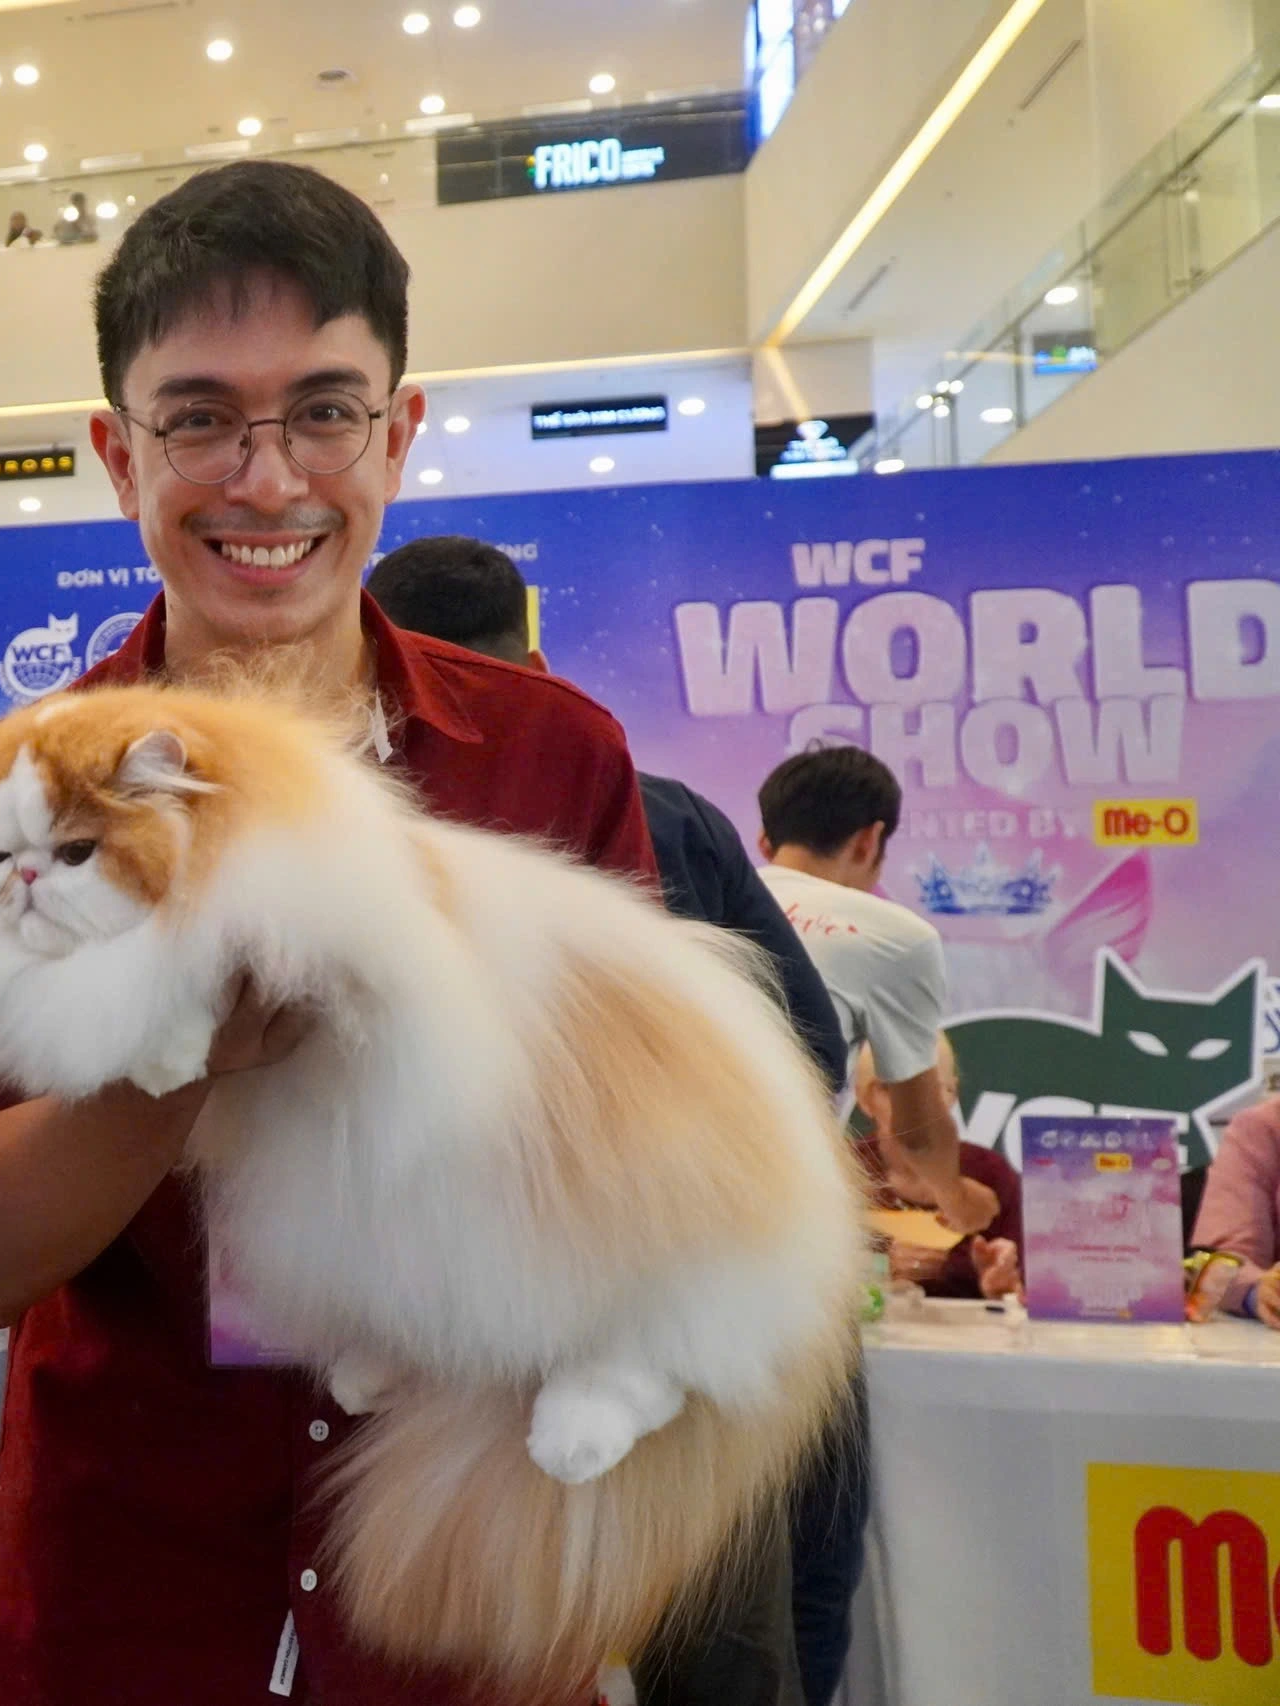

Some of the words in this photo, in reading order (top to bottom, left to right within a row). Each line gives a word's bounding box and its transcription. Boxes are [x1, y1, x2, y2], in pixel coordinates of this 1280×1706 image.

[535, 138, 622, 189] FRICO
[791, 538, 926, 587] WCF
[674, 579, 1280, 717] WORLD
